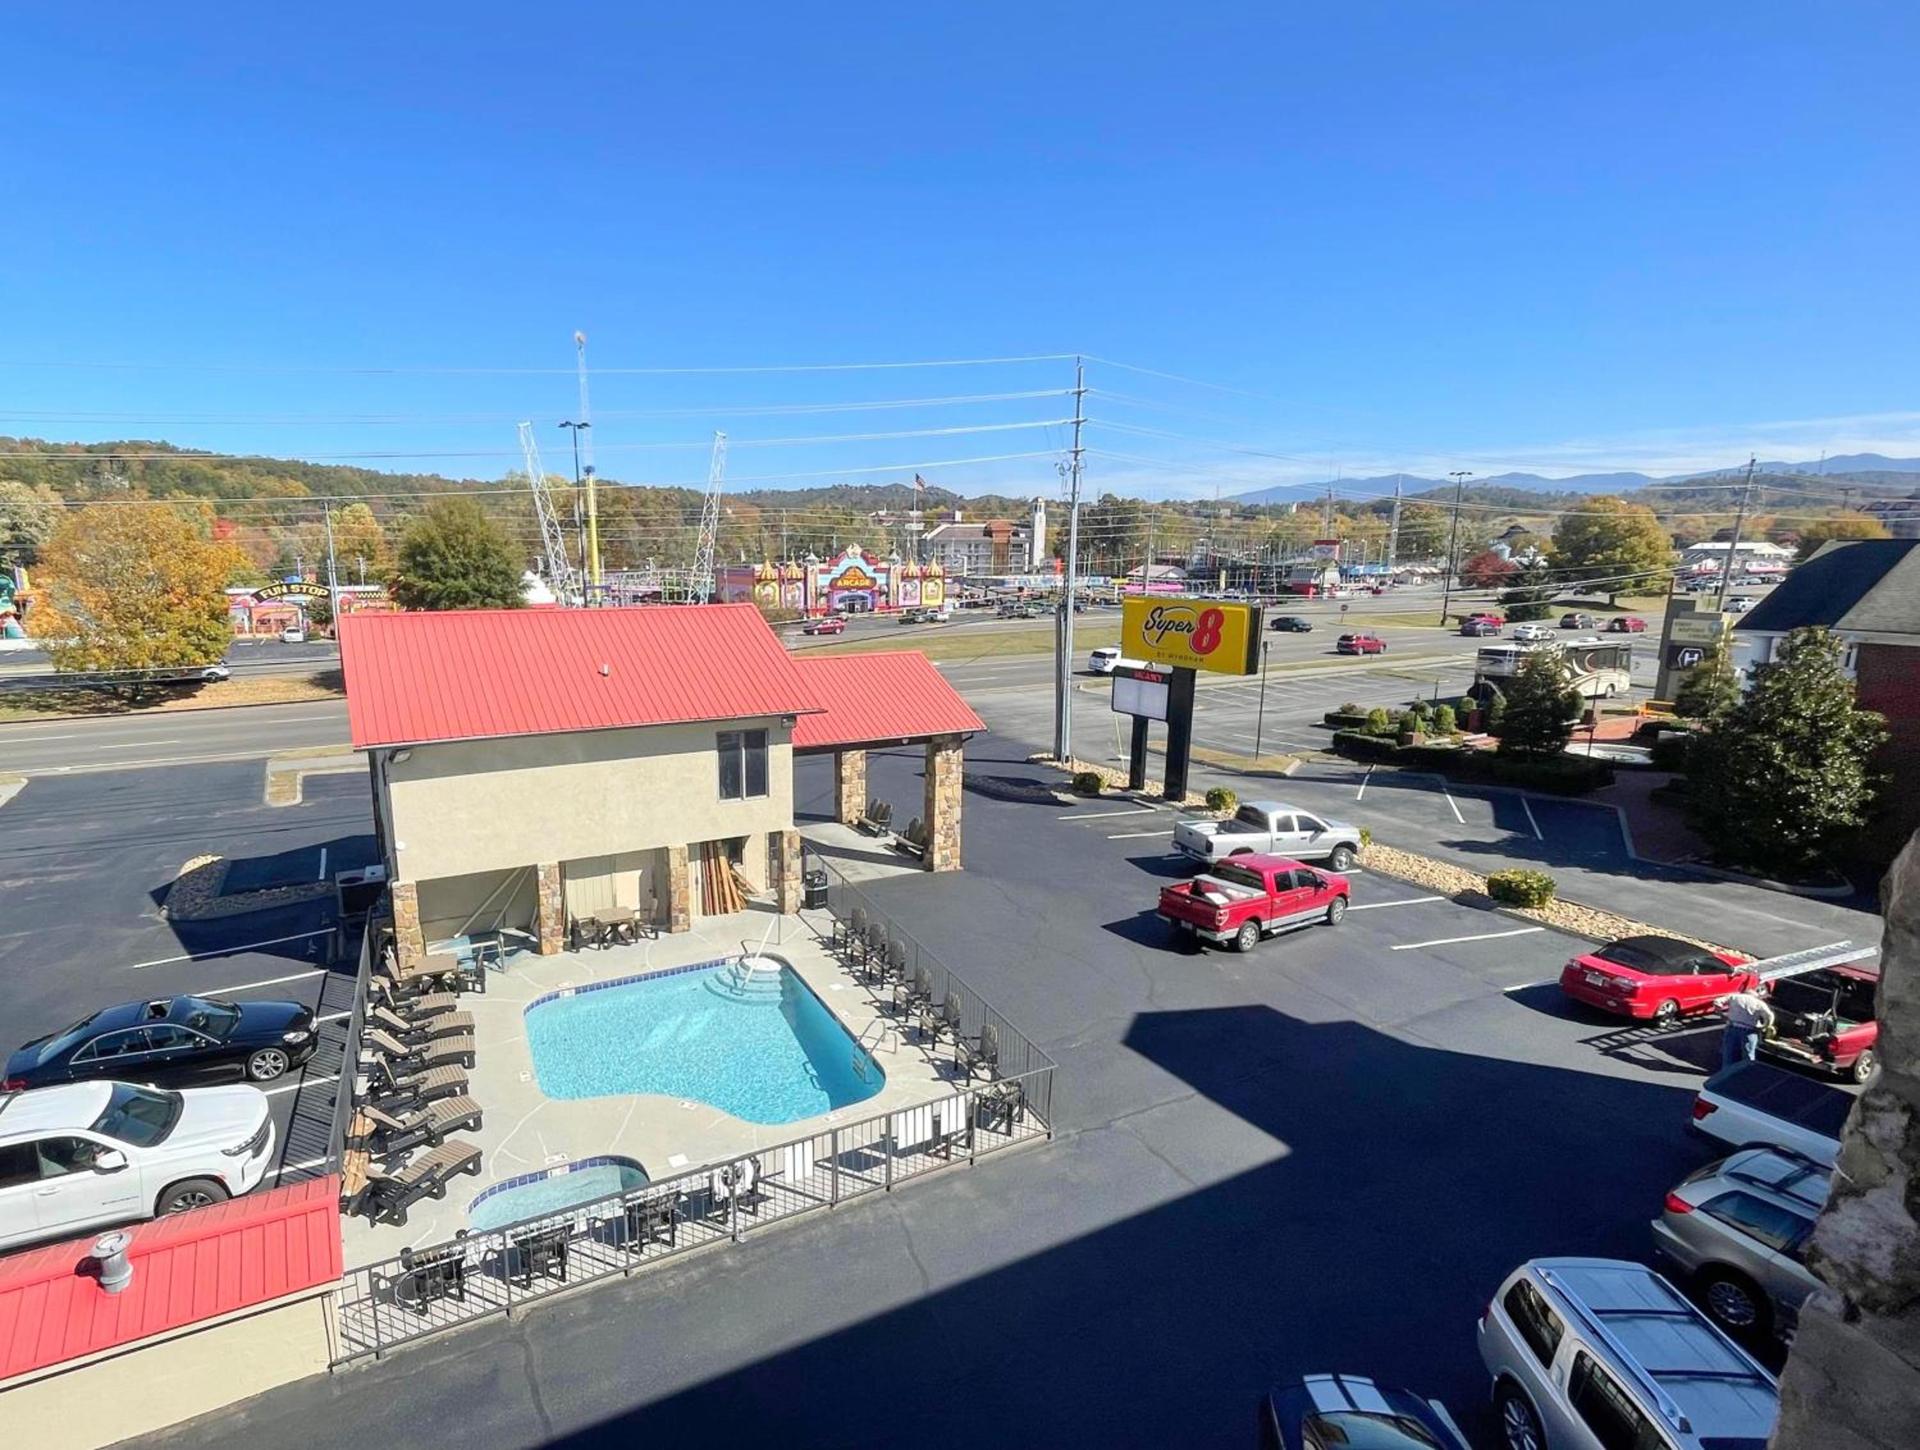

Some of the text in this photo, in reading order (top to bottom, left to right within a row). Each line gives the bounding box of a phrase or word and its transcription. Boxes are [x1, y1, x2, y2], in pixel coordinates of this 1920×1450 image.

[836, 578, 870, 587] ARCADE
[260, 584, 329, 599] FUN STOP
[1144, 606, 1225, 655] Super 8
